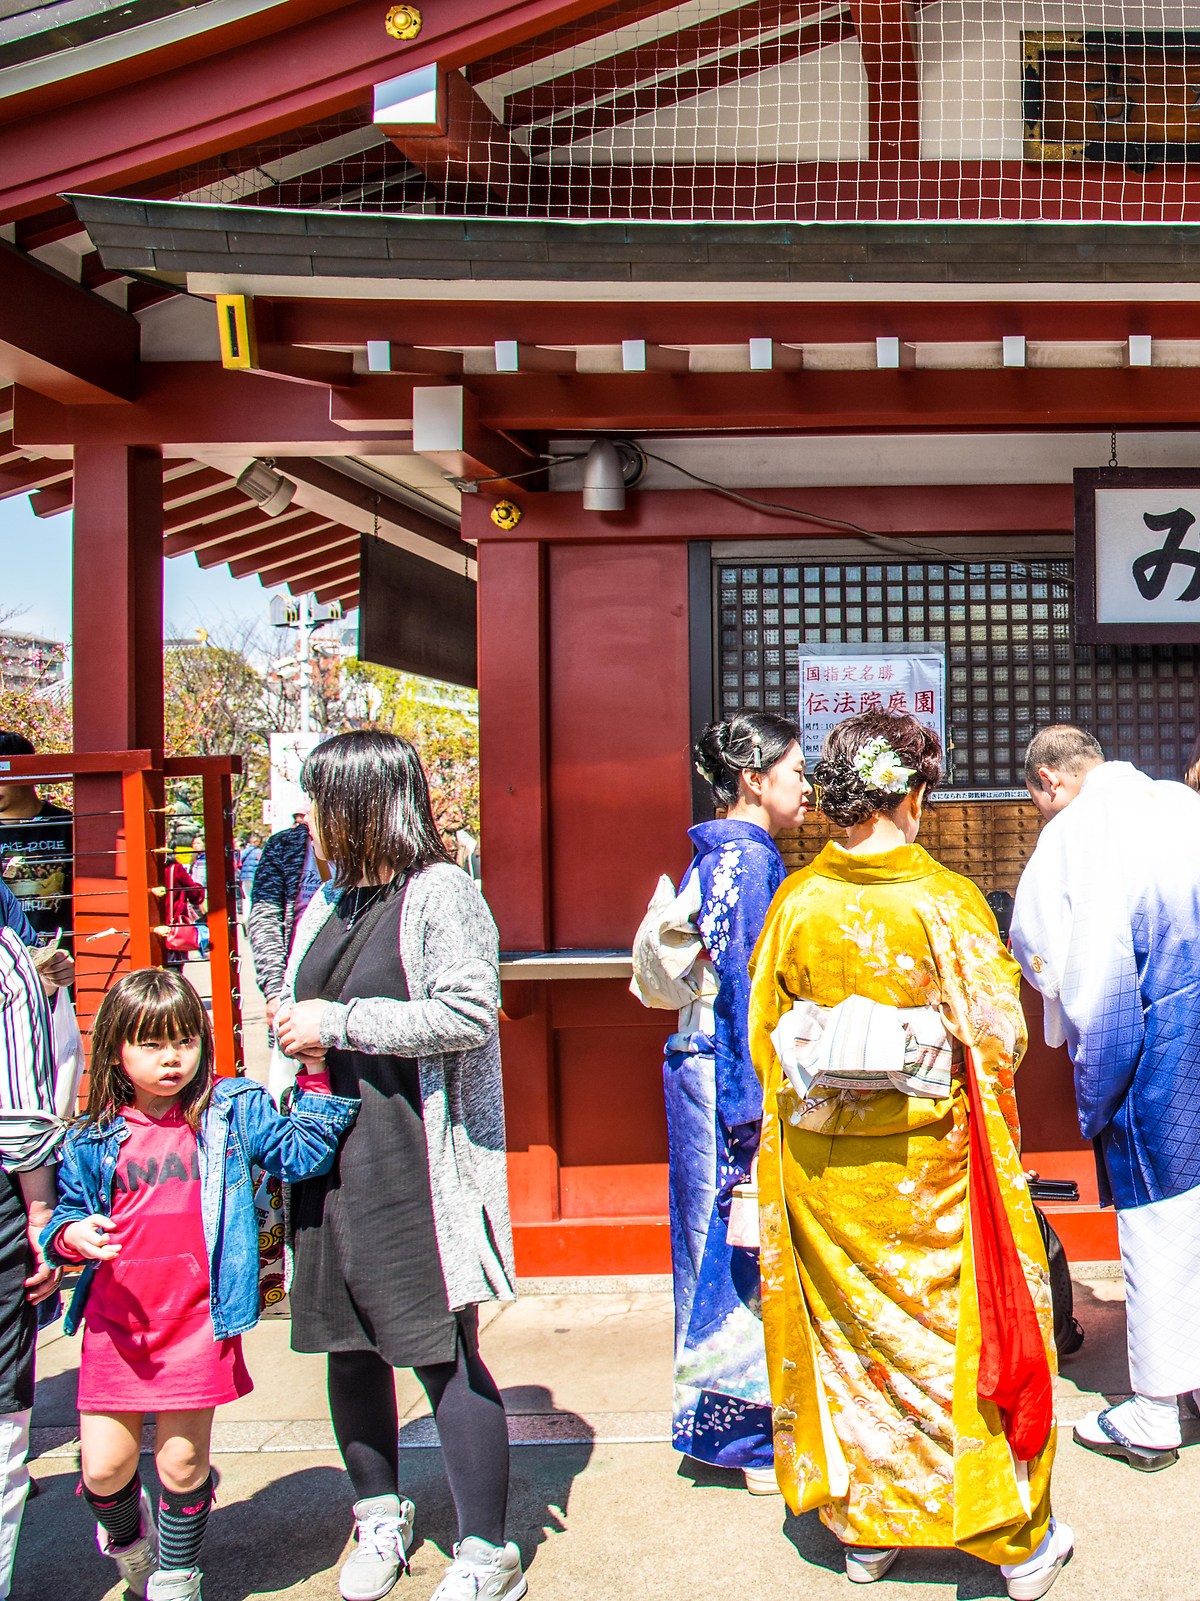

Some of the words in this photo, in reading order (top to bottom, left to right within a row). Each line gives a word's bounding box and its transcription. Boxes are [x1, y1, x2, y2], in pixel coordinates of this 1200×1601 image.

[807, 665, 895, 681] 国指定名勝
[805, 690, 934, 715] 伝法院庭園
